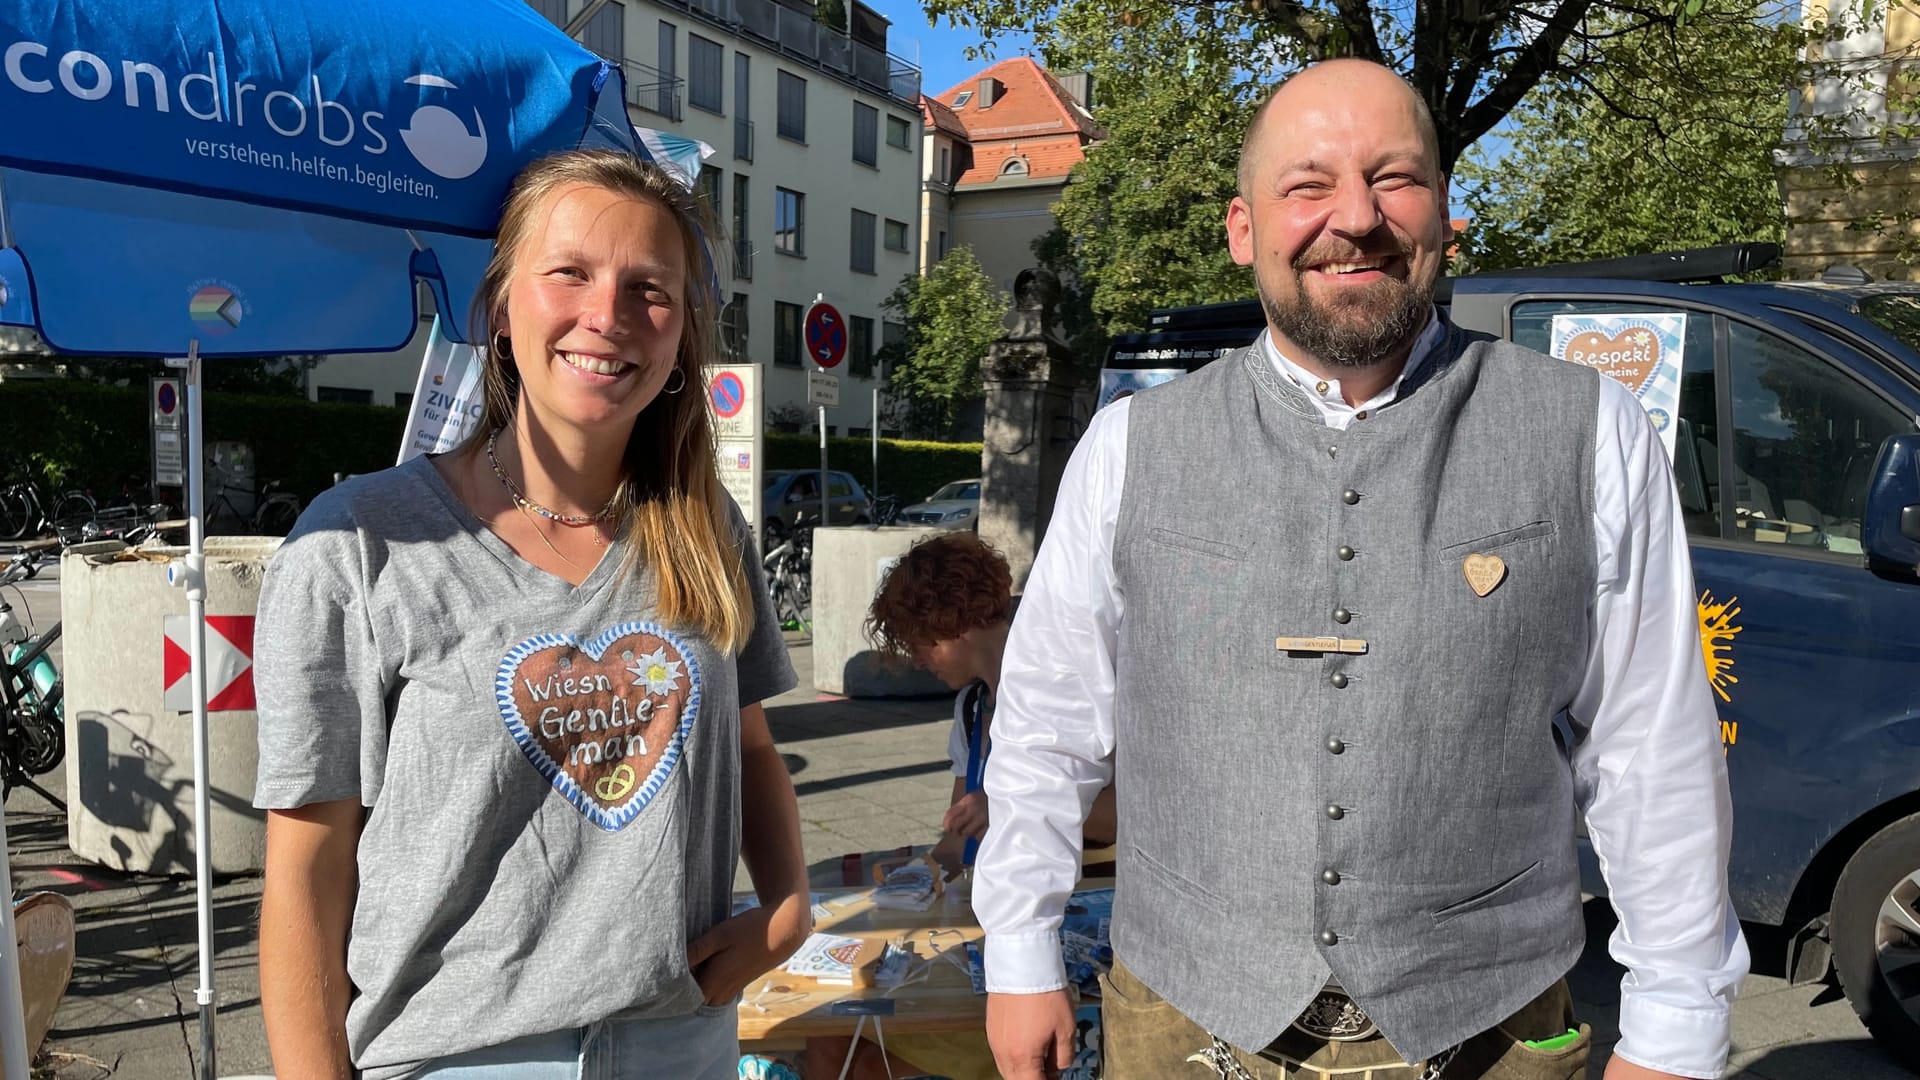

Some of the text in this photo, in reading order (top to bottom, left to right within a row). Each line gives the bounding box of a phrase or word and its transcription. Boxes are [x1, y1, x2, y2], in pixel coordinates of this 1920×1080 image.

[4, 41, 388, 155] condrobs
[185, 138, 440, 200] verstehen.helfen.begleiten.
[1160, 348, 1179, 360] Dich
[1572, 344, 1651, 368] Respekt
[423, 407, 440, 422] für
[718, 421, 741, 433] ONE
[524, 673, 612, 702] Wiesn
[538, 694, 669, 739] Gentle-
[569, 734, 648, 767] man
